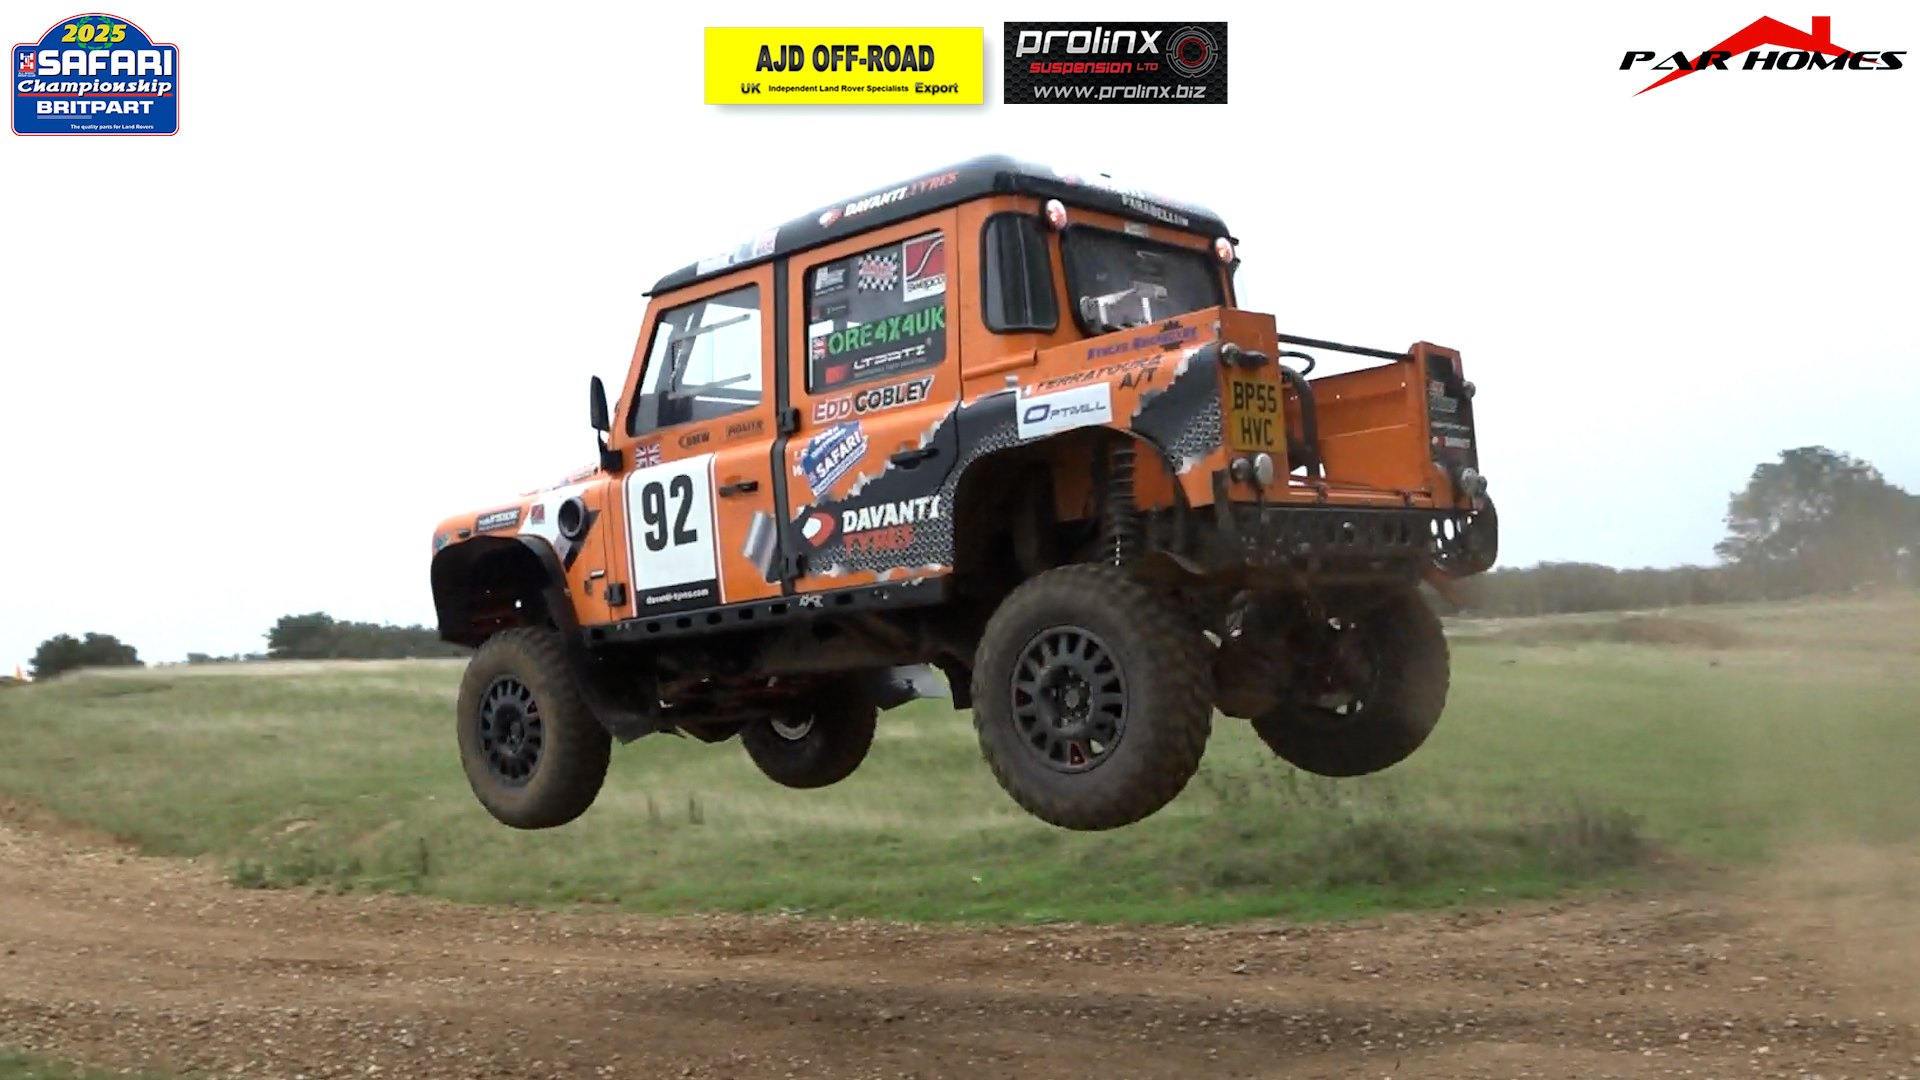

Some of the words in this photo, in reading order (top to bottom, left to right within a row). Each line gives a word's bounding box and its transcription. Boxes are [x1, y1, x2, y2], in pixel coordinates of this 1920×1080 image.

[844, 186, 908, 217] DAVANTI
[813, 396, 852, 423] EDD
[854, 377, 934, 413] COBLEY
[1233, 381, 1277, 413] BP55
[1241, 416, 1275, 446] HVC
[815, 431, 861, 478] SAFARI
[641, 474, 698, 551] 92
[842, 495, 941, 533] DAVANTI
